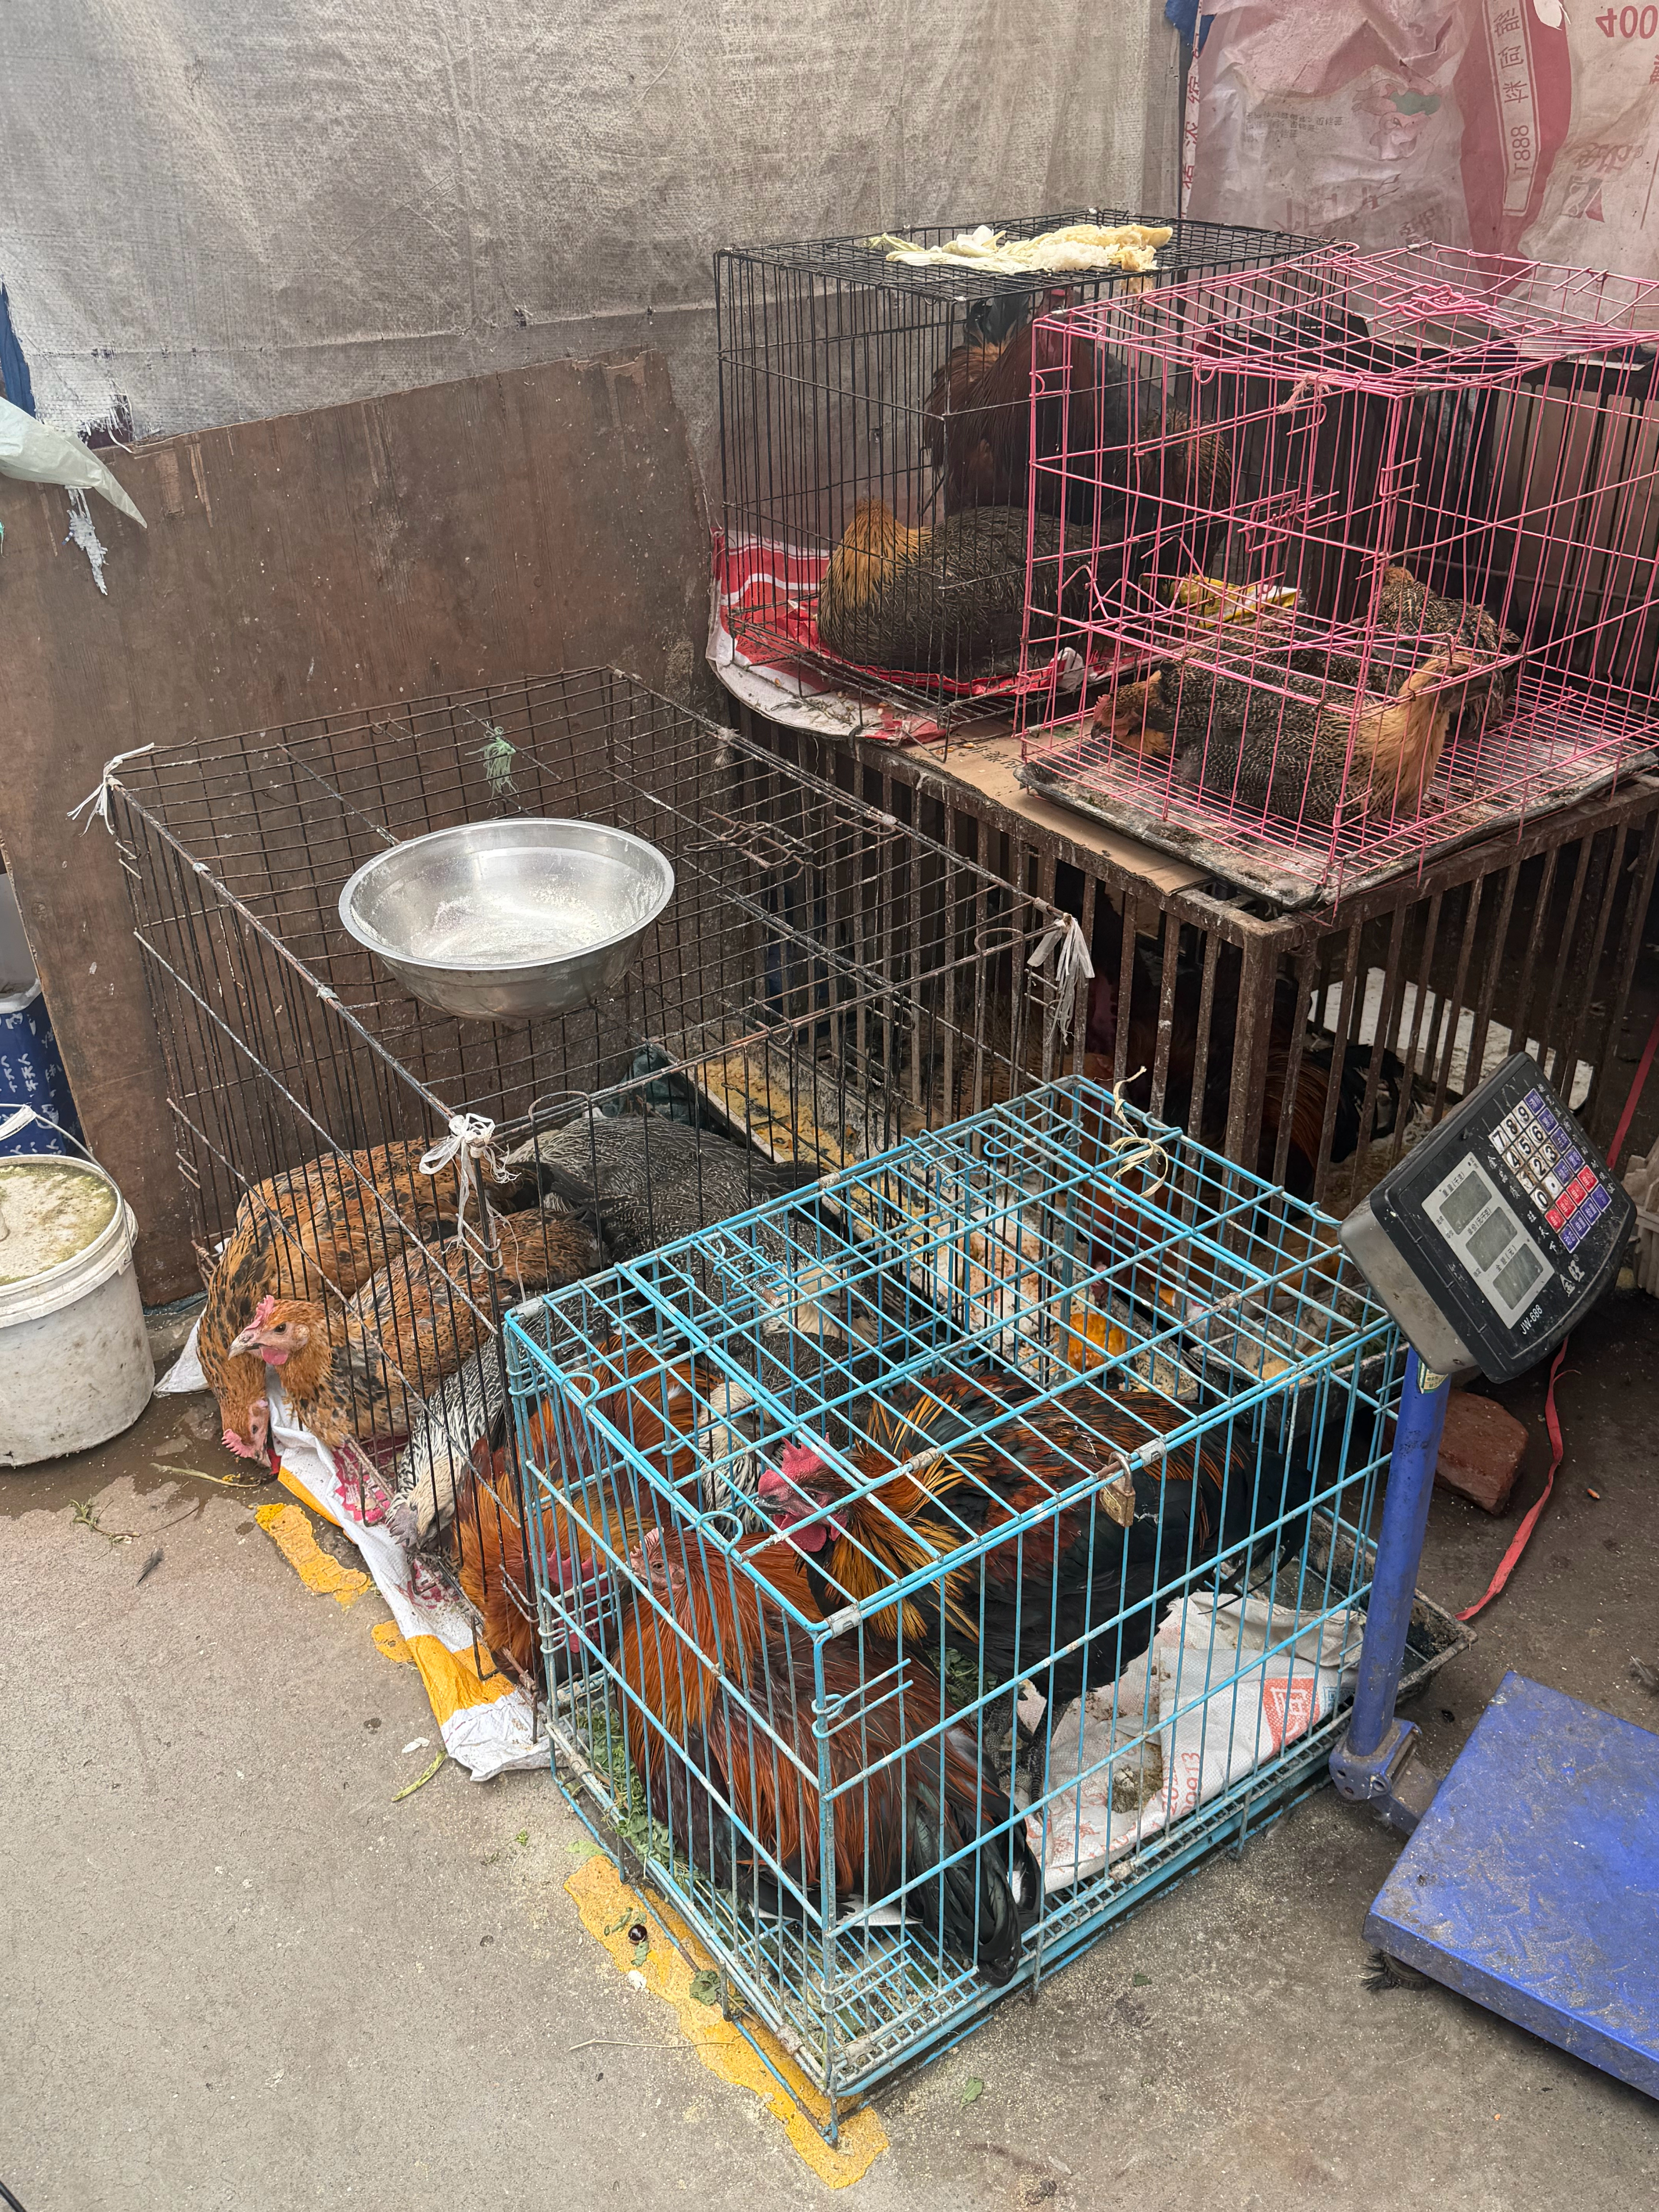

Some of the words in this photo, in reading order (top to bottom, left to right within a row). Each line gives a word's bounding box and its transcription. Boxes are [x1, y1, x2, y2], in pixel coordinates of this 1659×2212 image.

[1492, 1131, 1505, 1147] 7
[1506, 1119, 1518, 1135] 8
[1518, 1106, 1529, 1121] 9
[1510, 1151, 1520, 1167] 4
[1518, 1139, 1531, 1155] 5
[1532, 1126, 1544, 1141] 6
[1534, 1159, 1546, 1176] 2
[1545, 1145, 1557, 1161] 3
[1537, 1192, 1548, 1208] 0
[1520, 1304, 1542, 1335] JW-688
